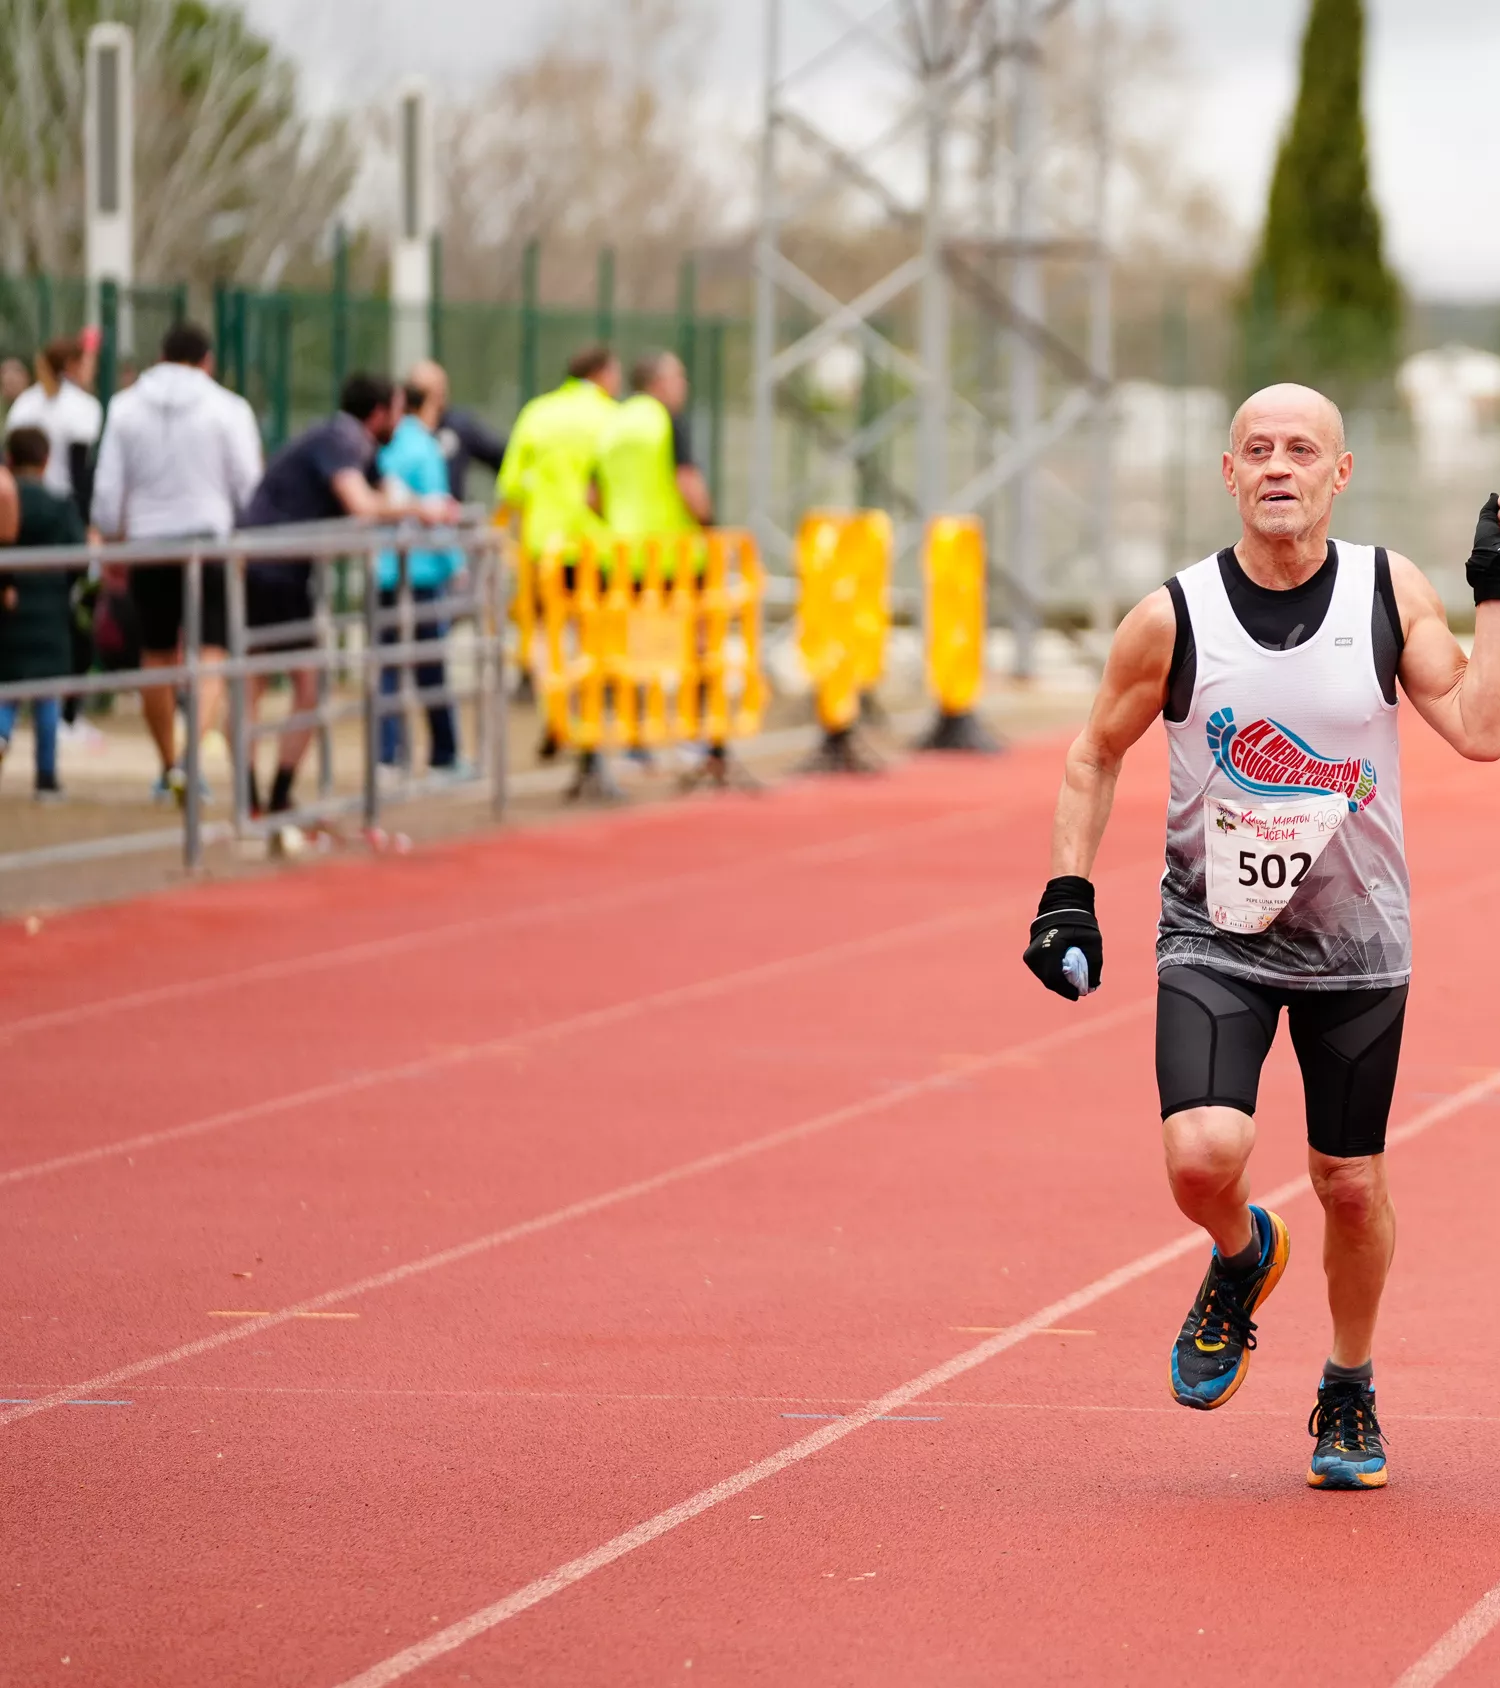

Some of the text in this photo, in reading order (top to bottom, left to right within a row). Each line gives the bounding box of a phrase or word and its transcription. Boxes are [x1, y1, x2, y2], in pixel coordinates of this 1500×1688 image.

[1231, 739, 1355, 798] CIUDAD DE LUCENA
[1237, 719, 1361, 783] IX MEDIA MARATÓN
[1256, 825, 1301, 840] LUCENA
[1239, 850, 1312, 889] 502
